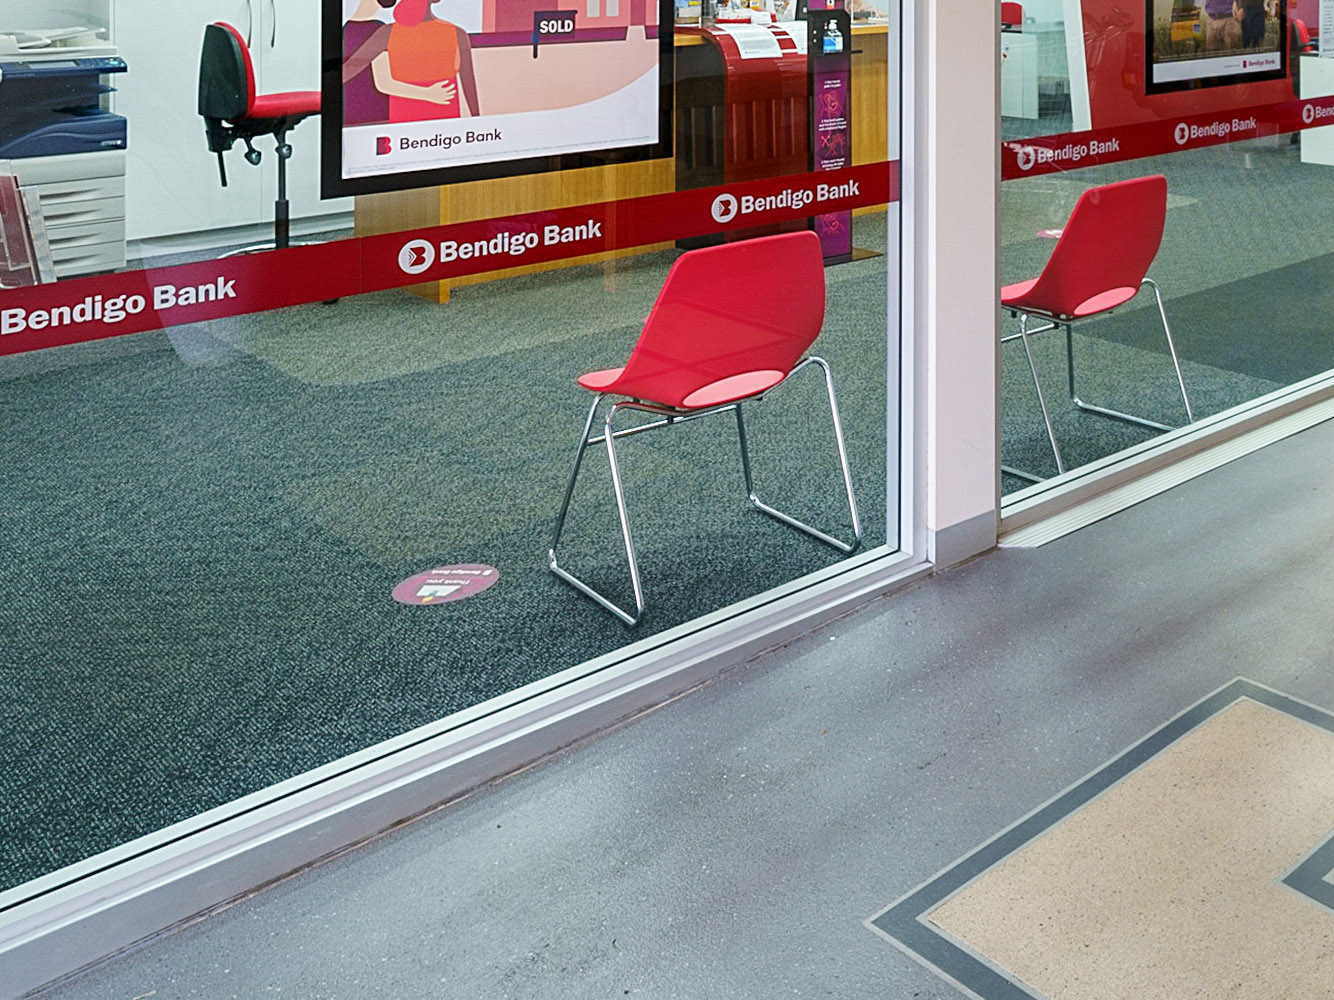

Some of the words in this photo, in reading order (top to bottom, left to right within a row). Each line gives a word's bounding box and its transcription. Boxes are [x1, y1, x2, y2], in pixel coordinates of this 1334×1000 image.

[539, 19, 574, 34] SOLD
[400, 132, 461, 151] Bendigo
[466, 129, 502, 143] Bank
[1190, 122, 1230, 139] Bendigo
[1232, 117, 1256, 131] Bank
[1037, 143, 1087, 164] Bendigo
[1089, 138, 1120, 155] Bank
[741, 187, 812, 214] Bendigo
[816, 179, 860, 201] Bank
[440, 225, 539, 264] Bendigo
[545, 218, 603, 248] Bank
[1, 294, 146, 335] Bendigo
[154, 276, 237, 310] Bank
